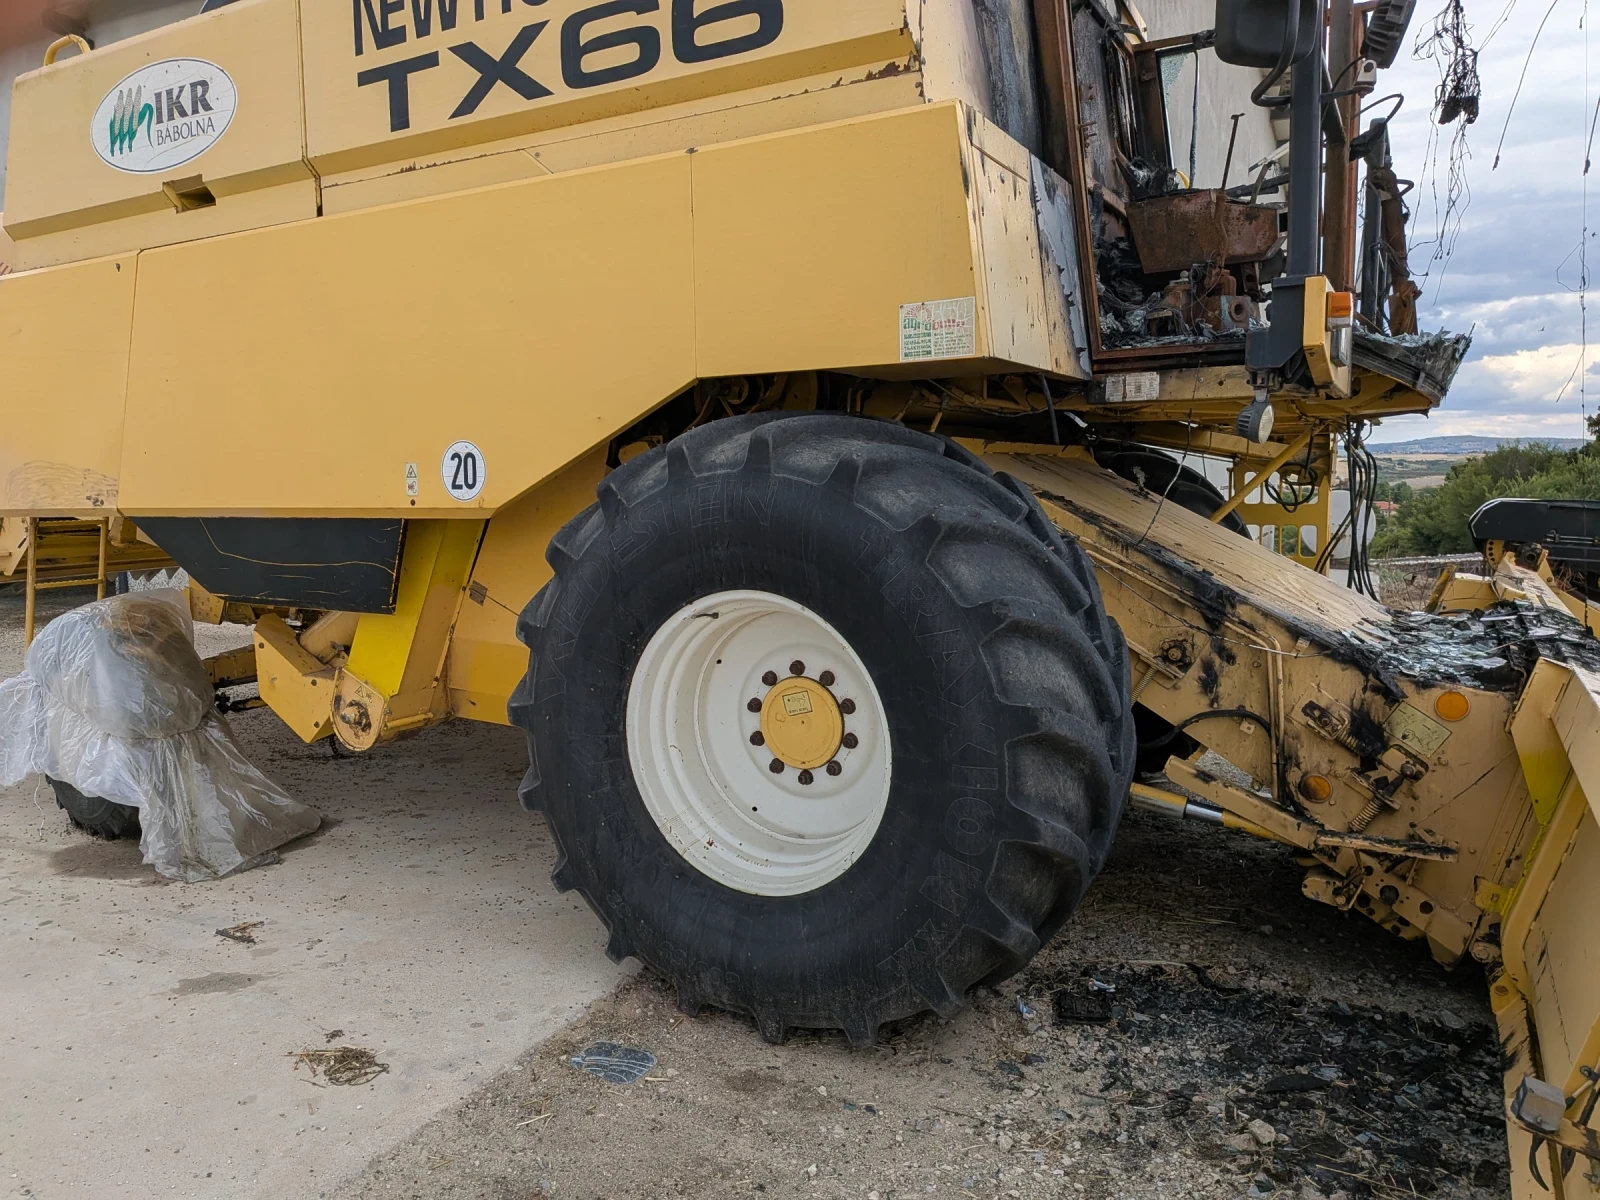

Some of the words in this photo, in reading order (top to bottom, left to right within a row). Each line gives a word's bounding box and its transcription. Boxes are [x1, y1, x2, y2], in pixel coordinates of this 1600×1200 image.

[356, 0, 784, 133] TX66
[153, 79, 214, 125] IKR
[156, 115, 216, 146] BÁBOLNA
[450, 452, 477, 490] 20
